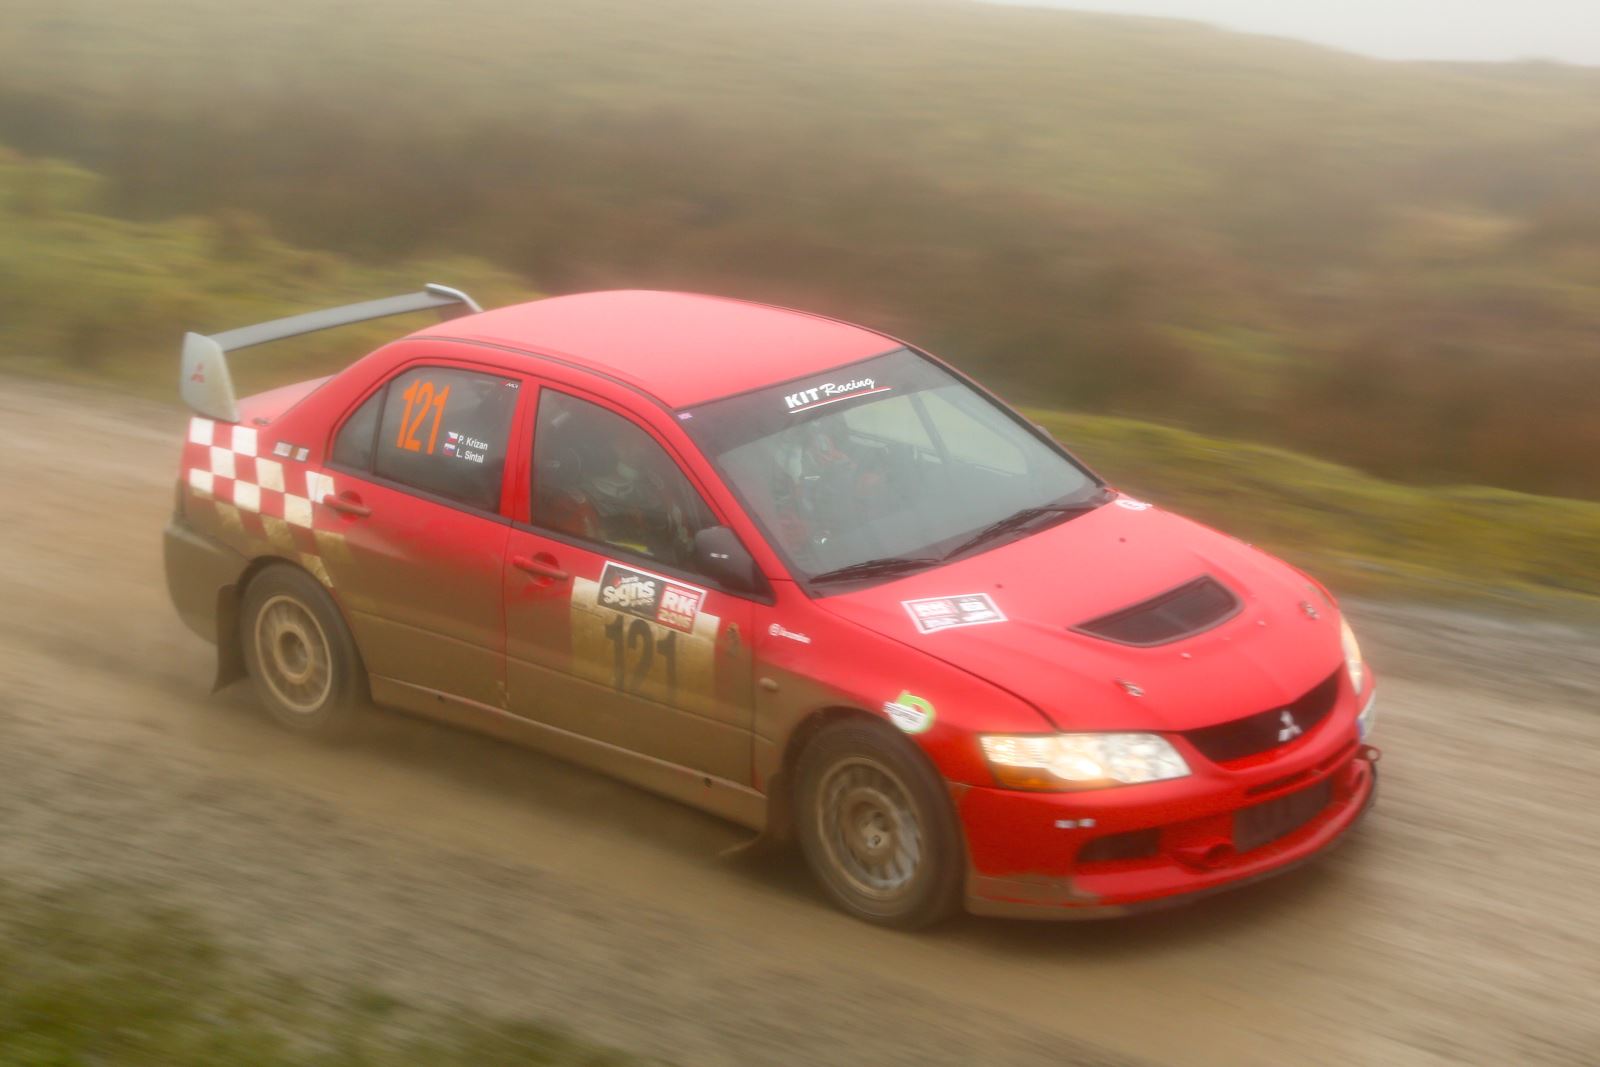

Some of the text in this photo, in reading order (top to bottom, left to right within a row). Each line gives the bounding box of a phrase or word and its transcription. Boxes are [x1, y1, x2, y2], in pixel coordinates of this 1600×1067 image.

[784, 378, 875, 409] KIT Racing
[396, 379, 451, 456] 121
[455, 448, 463, 459] L.
[457, 434, 489, 451] P. Krizan
[604, 613, 680, 697] 121
